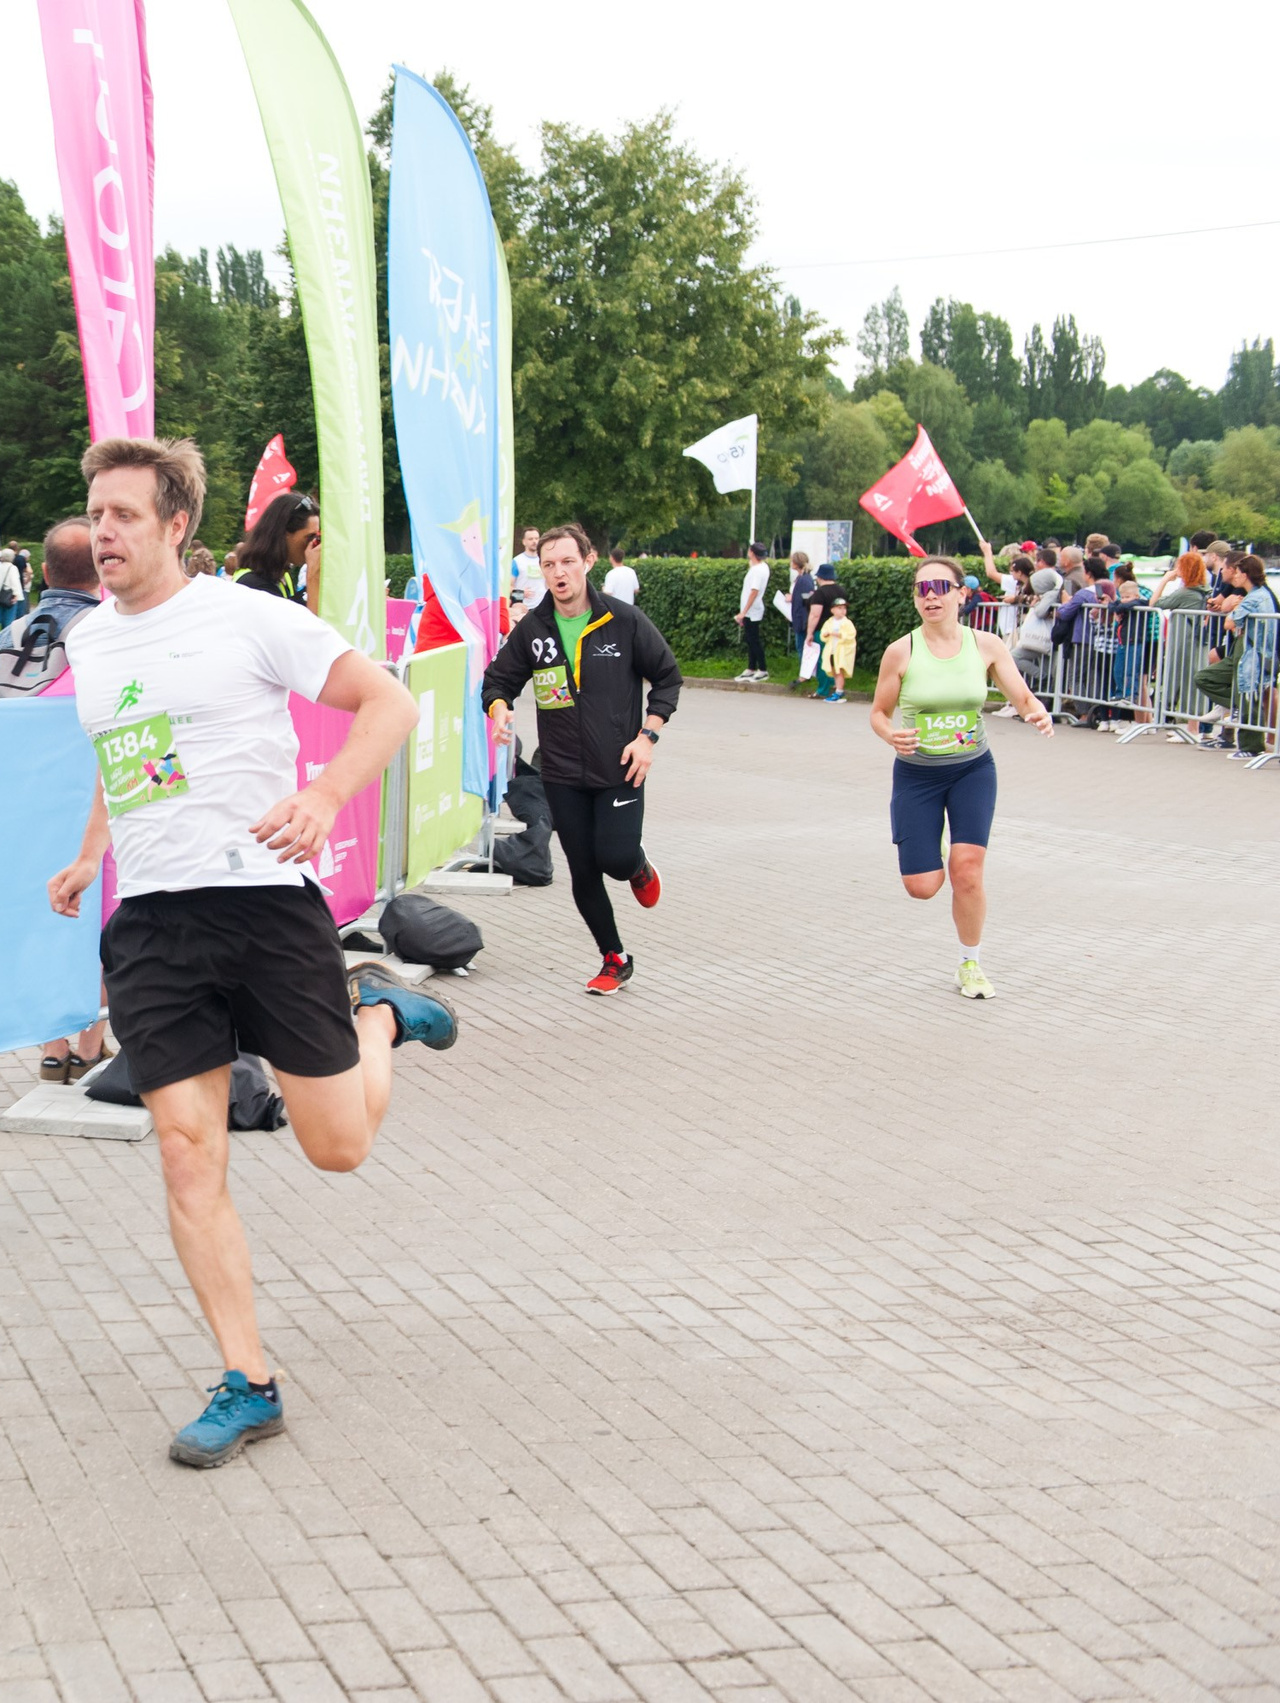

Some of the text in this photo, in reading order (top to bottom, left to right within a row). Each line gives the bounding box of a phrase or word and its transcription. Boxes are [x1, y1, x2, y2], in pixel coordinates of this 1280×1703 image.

[531, 636, 558, 664] 93
[924, 714, 968, 730] 1450
[102, 725, 158, 766] 1384
